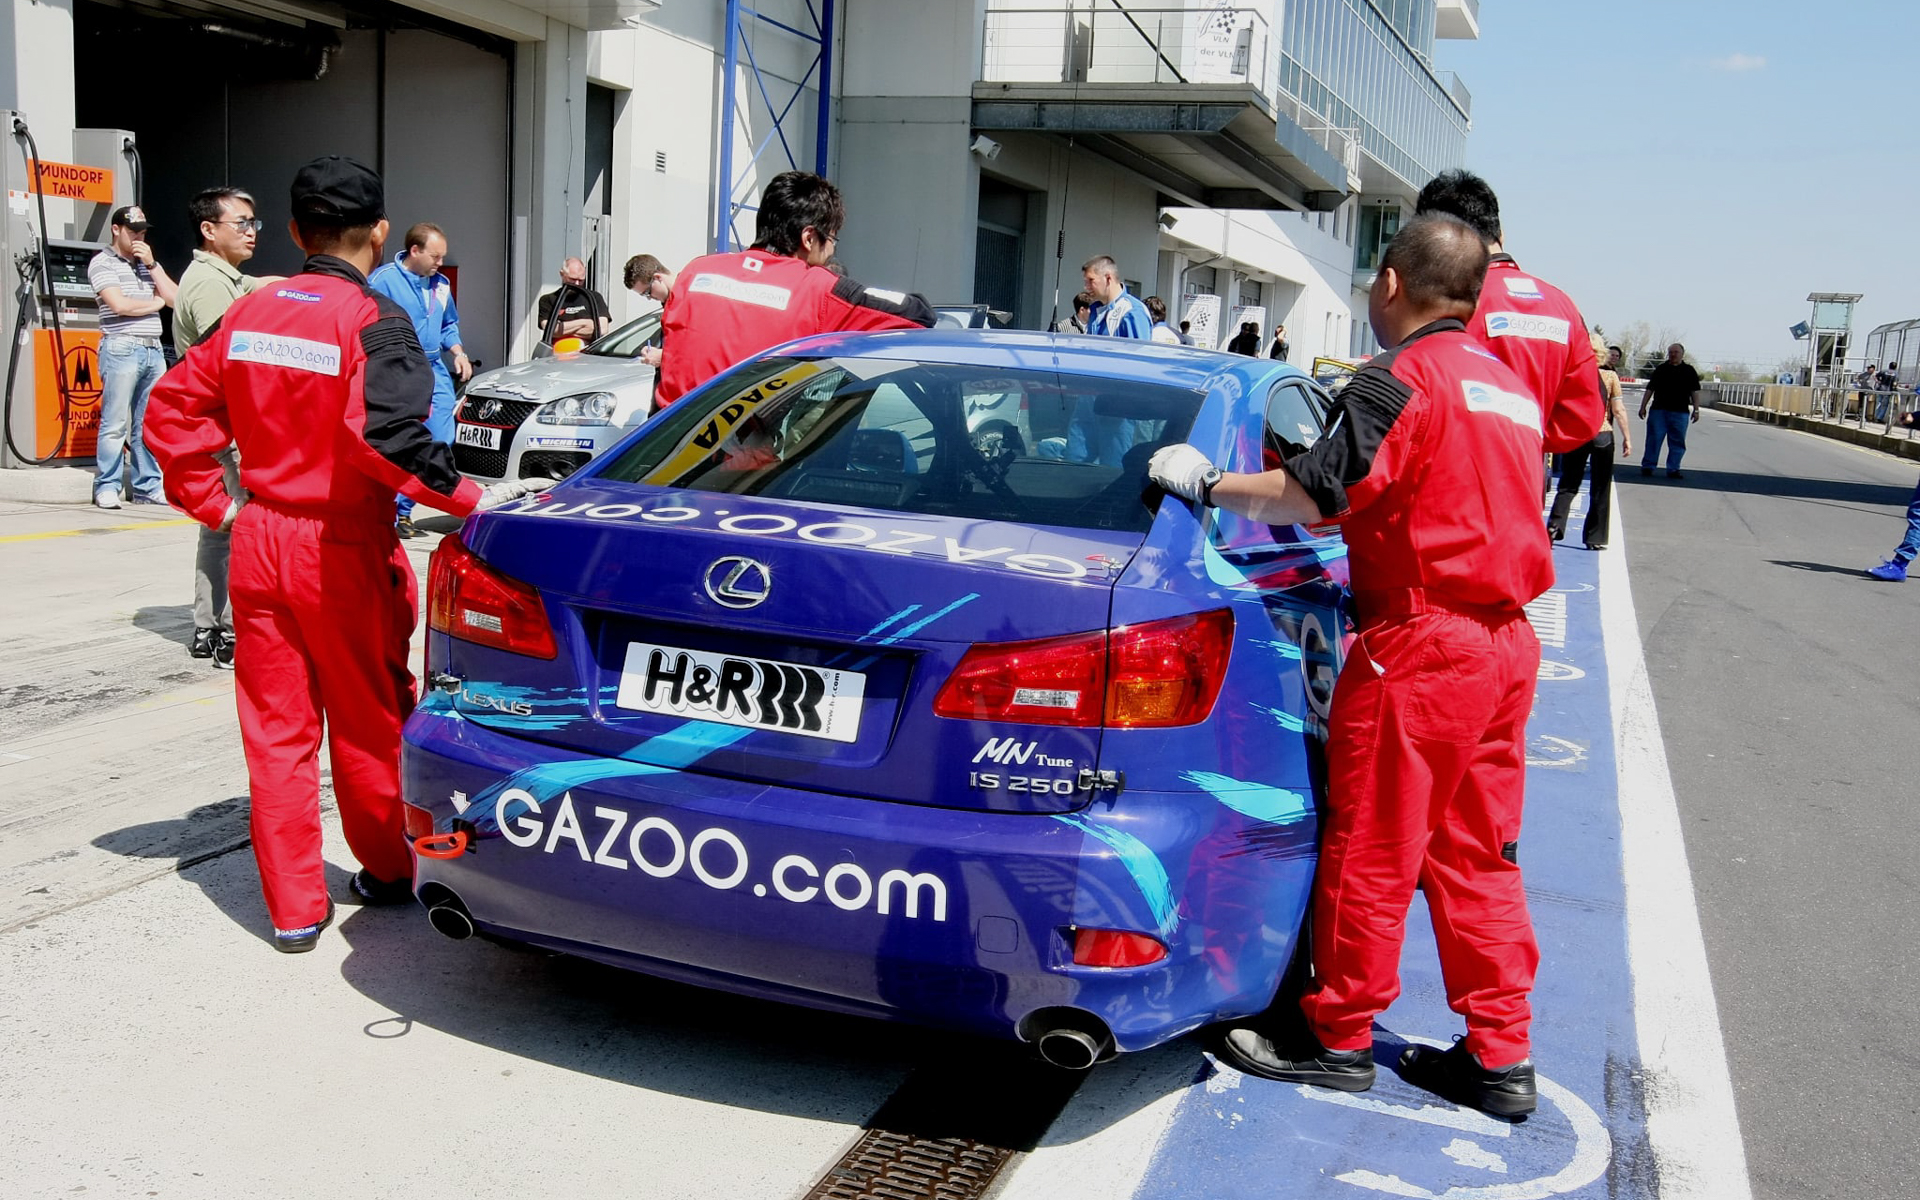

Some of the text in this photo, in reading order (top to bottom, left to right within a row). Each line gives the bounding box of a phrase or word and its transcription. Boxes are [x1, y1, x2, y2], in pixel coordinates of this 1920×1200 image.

[1213, 35, 1230, 43] VLN
[1200, 47, 1215, 57] der
[35, 164, 104, 184] MUNDORF
[52, 182, 85, 198] TANK
[253, 340, 337, 367] GAZOO.com
[70, 420, 99, 431] TANK
[541, 438, 592, 447] MICHELIN
[493, 502, 1088, 578] GAZOO.com
[462, 688, 532, 716] LEXUS
[971, 737, 1074, 767] MN Tune
[970, 771, 1074, 795] IS 250
[495, 788, 947, 922] GAZOO.com
